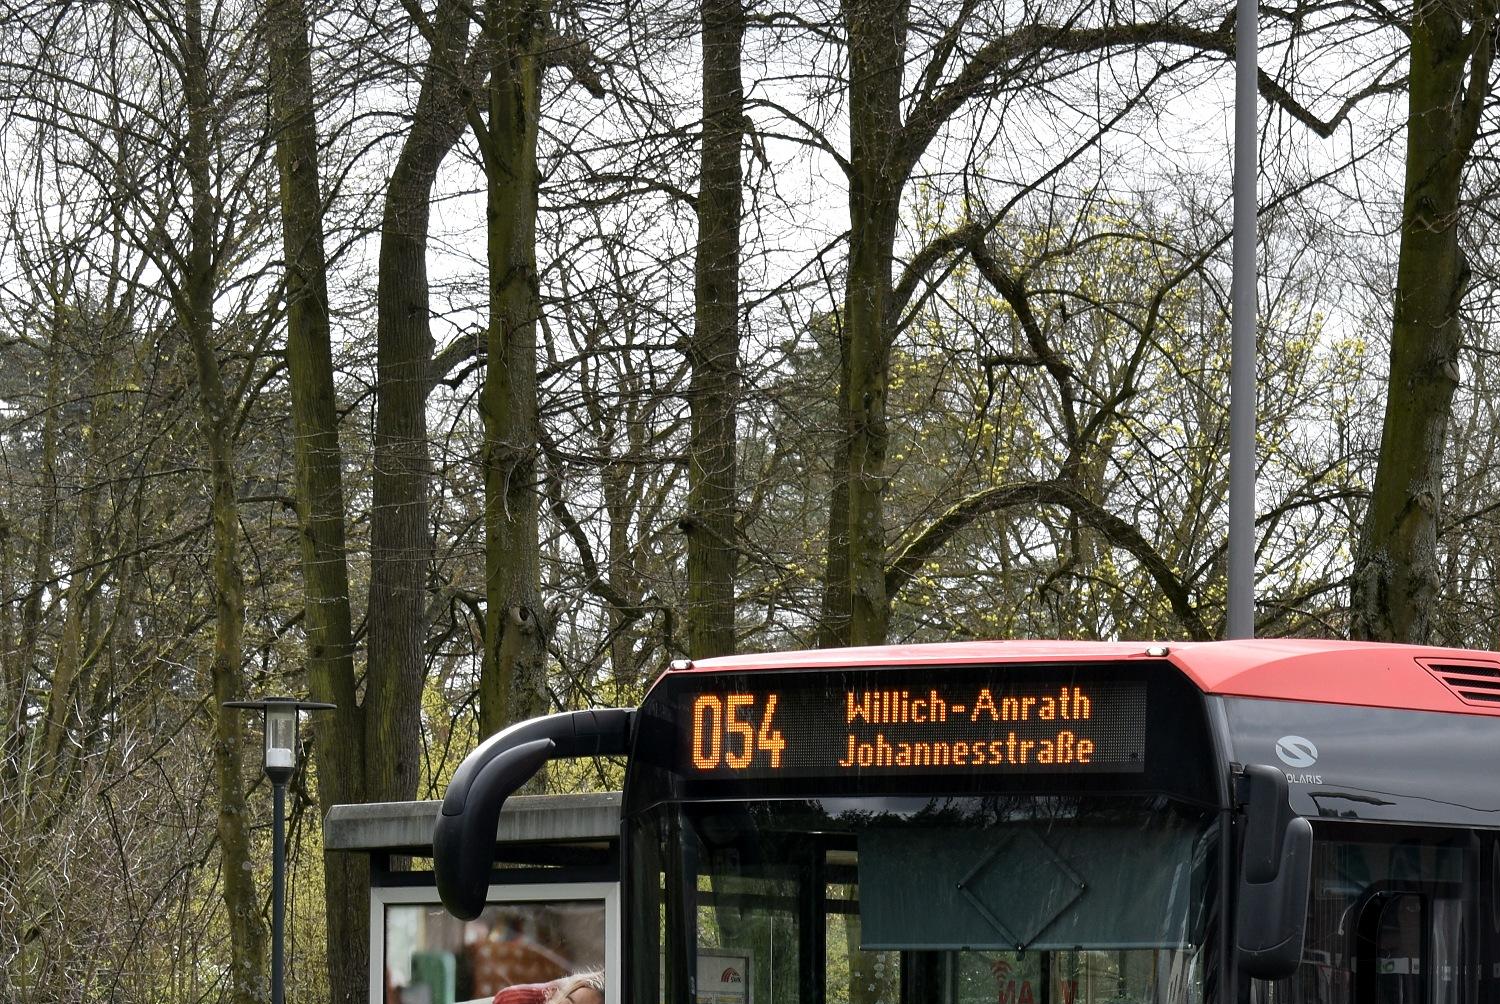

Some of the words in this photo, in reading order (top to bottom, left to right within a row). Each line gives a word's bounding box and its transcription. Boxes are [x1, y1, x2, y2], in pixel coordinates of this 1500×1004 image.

[848, 688, 1090, 724] Willich-Anrath
[692, 694, 786, 768] 054
[838, 731, 1094, 767] Johannesstraße
[1286, 774, 1323, 784] OLARIS
